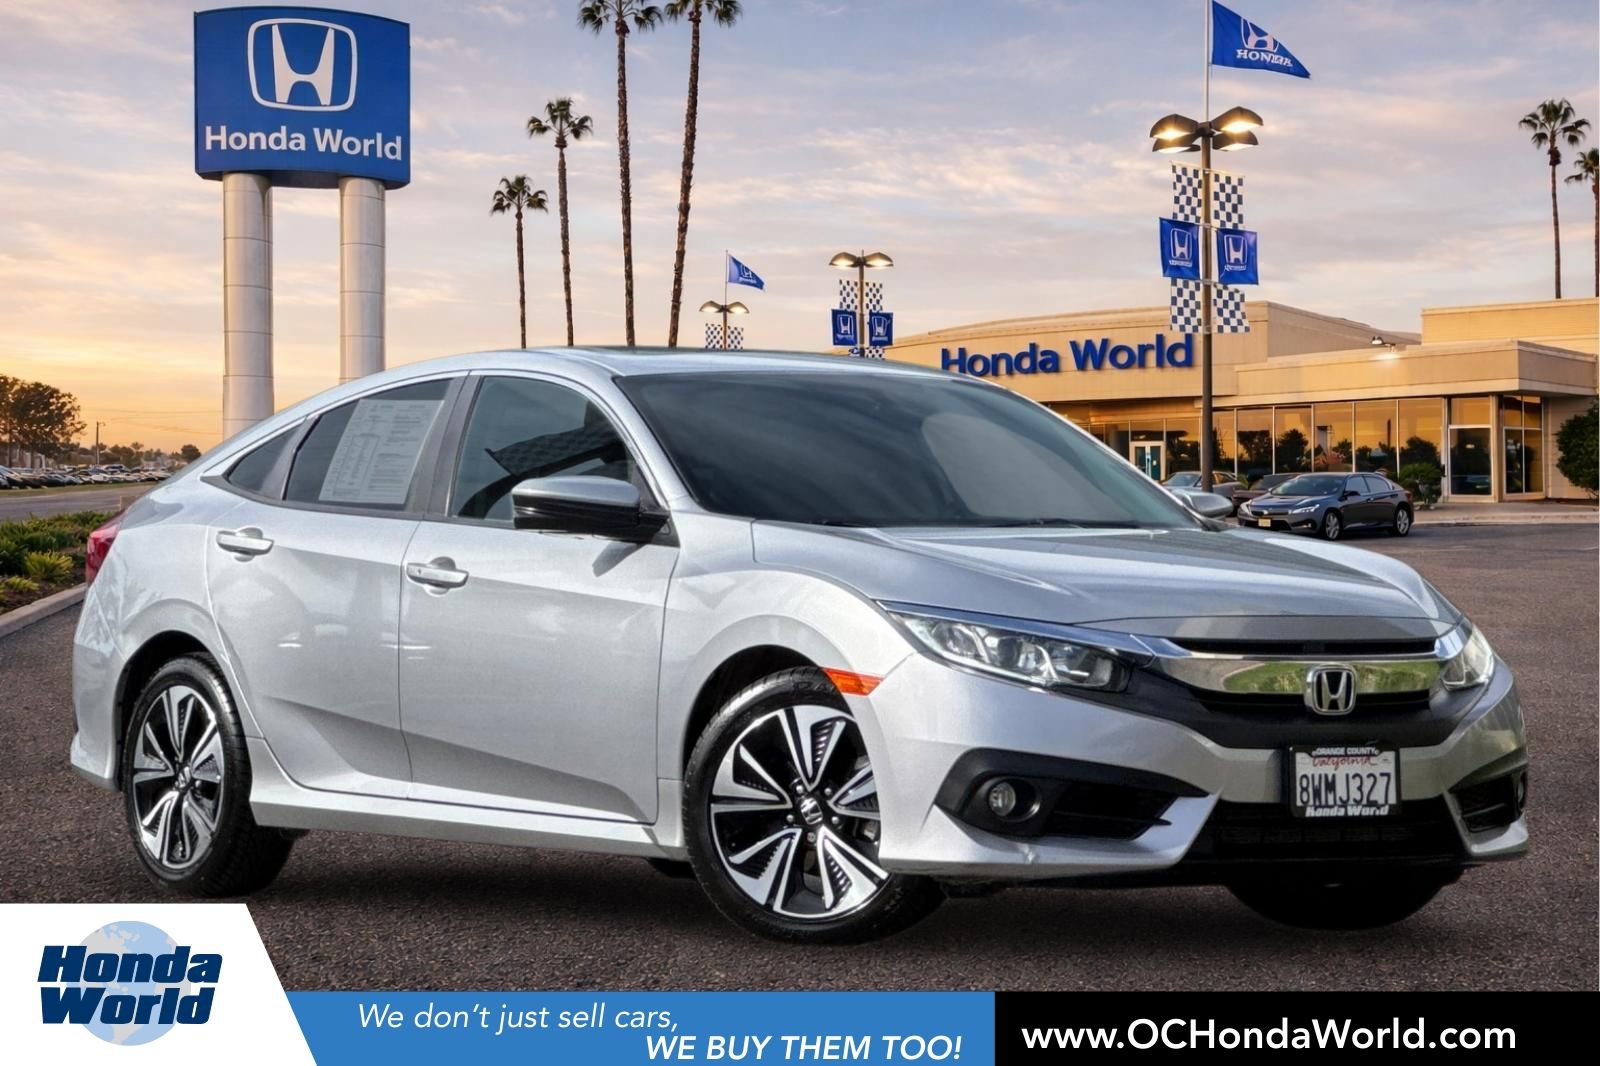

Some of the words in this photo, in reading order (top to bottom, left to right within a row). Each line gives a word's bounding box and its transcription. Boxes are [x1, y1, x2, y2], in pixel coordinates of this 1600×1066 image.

[205, 125, 306, 151] Honda
[313, 127, 402, 161] World
[941, 342, 1060, 377] Honda
[1069, 333, 1193, 370] World
[1316, 747, 1345, 756] ORANGE
[1347, 746, 1376, 755] COUNTY
[1299, 773, 1391, 807] 8WMJ327
